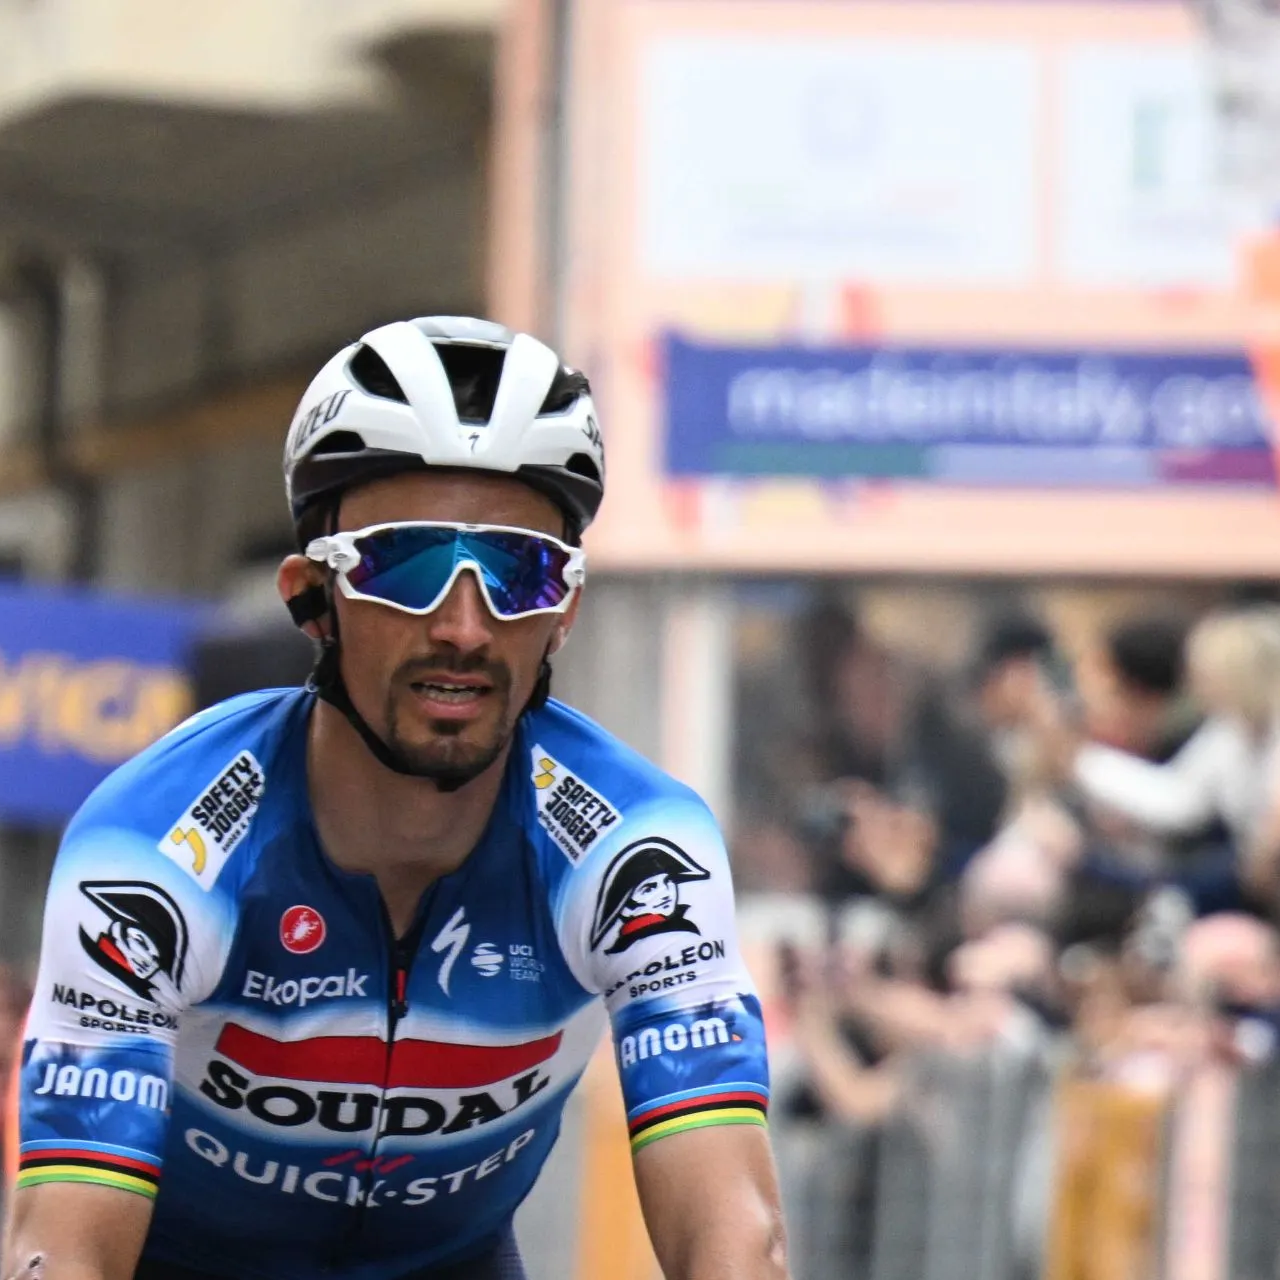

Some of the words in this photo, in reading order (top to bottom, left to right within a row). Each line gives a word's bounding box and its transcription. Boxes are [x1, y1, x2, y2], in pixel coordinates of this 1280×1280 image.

[191, 756, 253, 827] SAFETY
[557, 776, 617, 829] SAFETY
[545, 791, 598, 852] JOGGER
[508, 944, 534, 956] UCI
[242, 968, 370, 1007] Ekopak
[629, 971, 697, 998] SPORTS
[198, 1059, 551, 1137] SOUDAL
